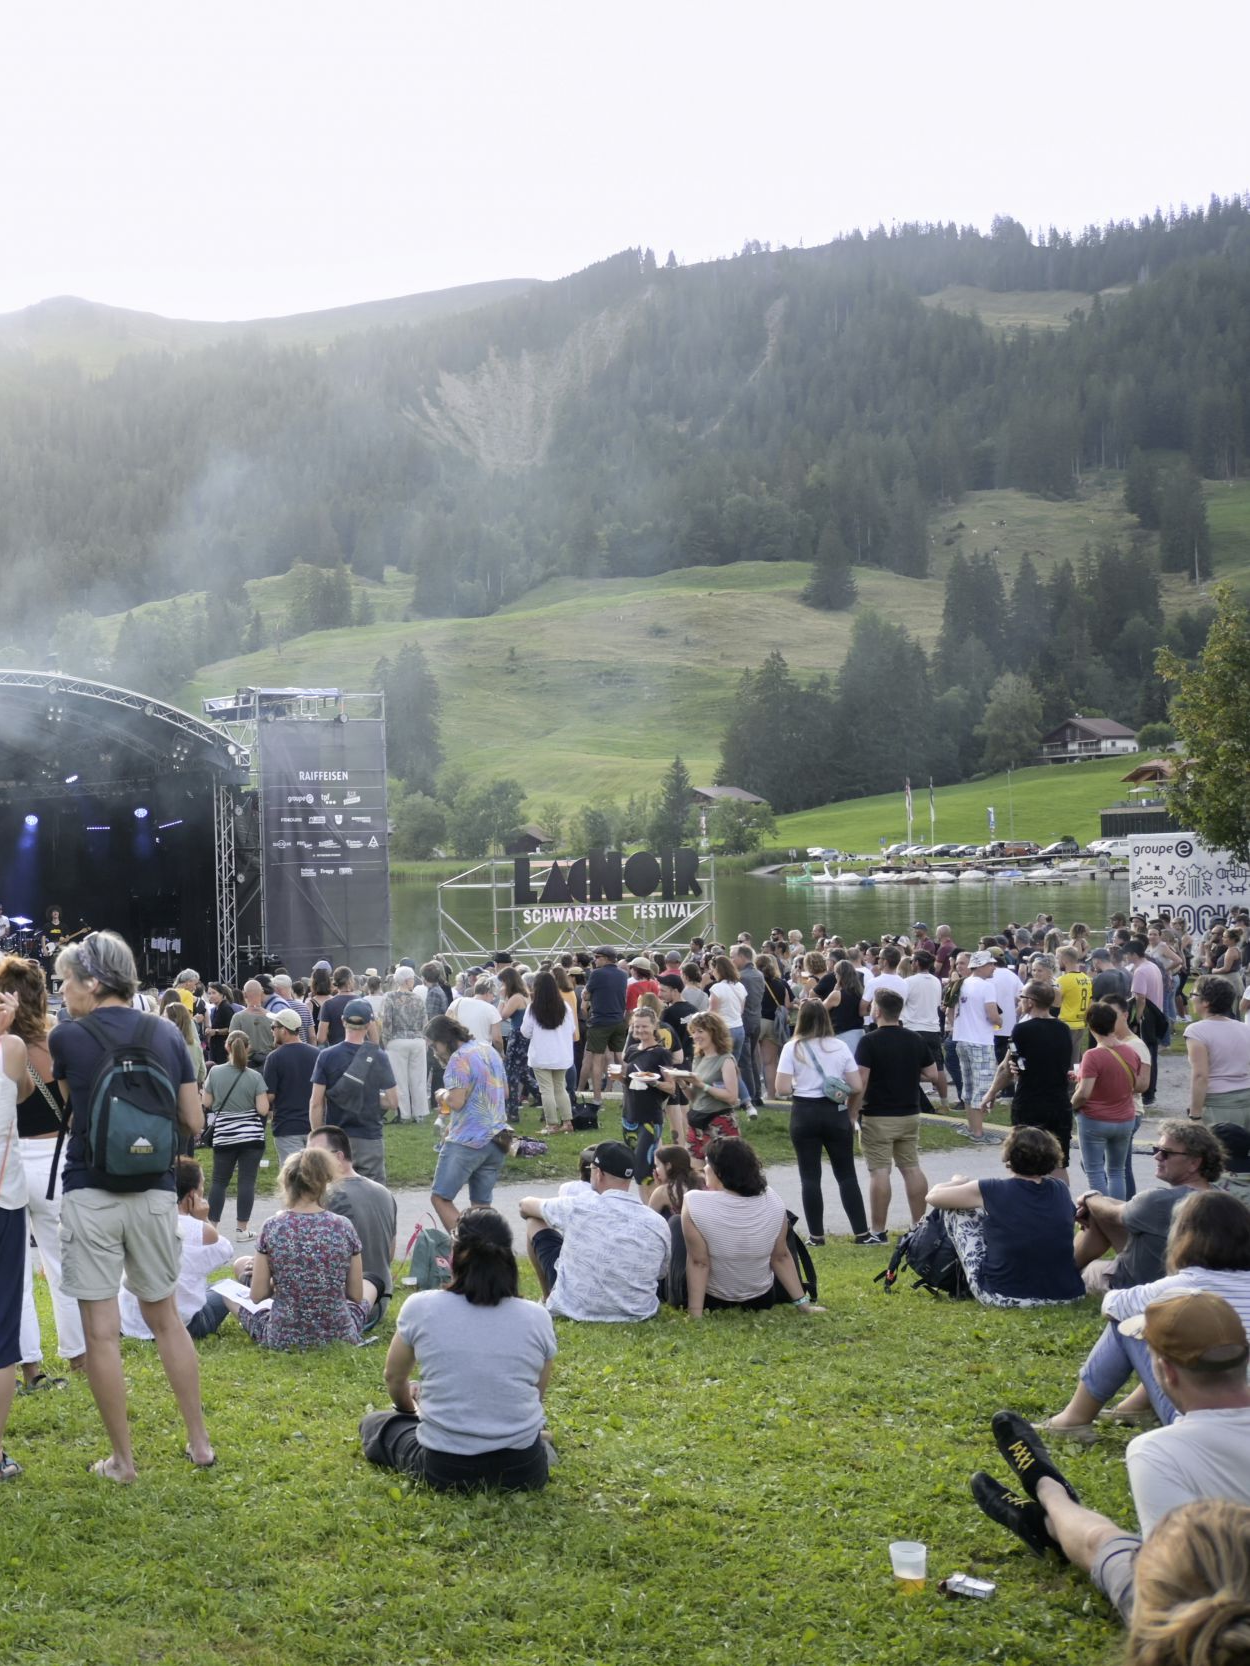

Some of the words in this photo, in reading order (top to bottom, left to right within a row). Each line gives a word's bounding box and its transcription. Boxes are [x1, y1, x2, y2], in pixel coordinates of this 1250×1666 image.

[299, 771, 349, 781] RAIFFEISEN
[1133, 845, 1174, 857] groupe
[523, 905, 618, 925] SCHWARZSEE
[633, 903, 692, 919] FESTIVAL
[1081, 988, 1088, 1011] 8
